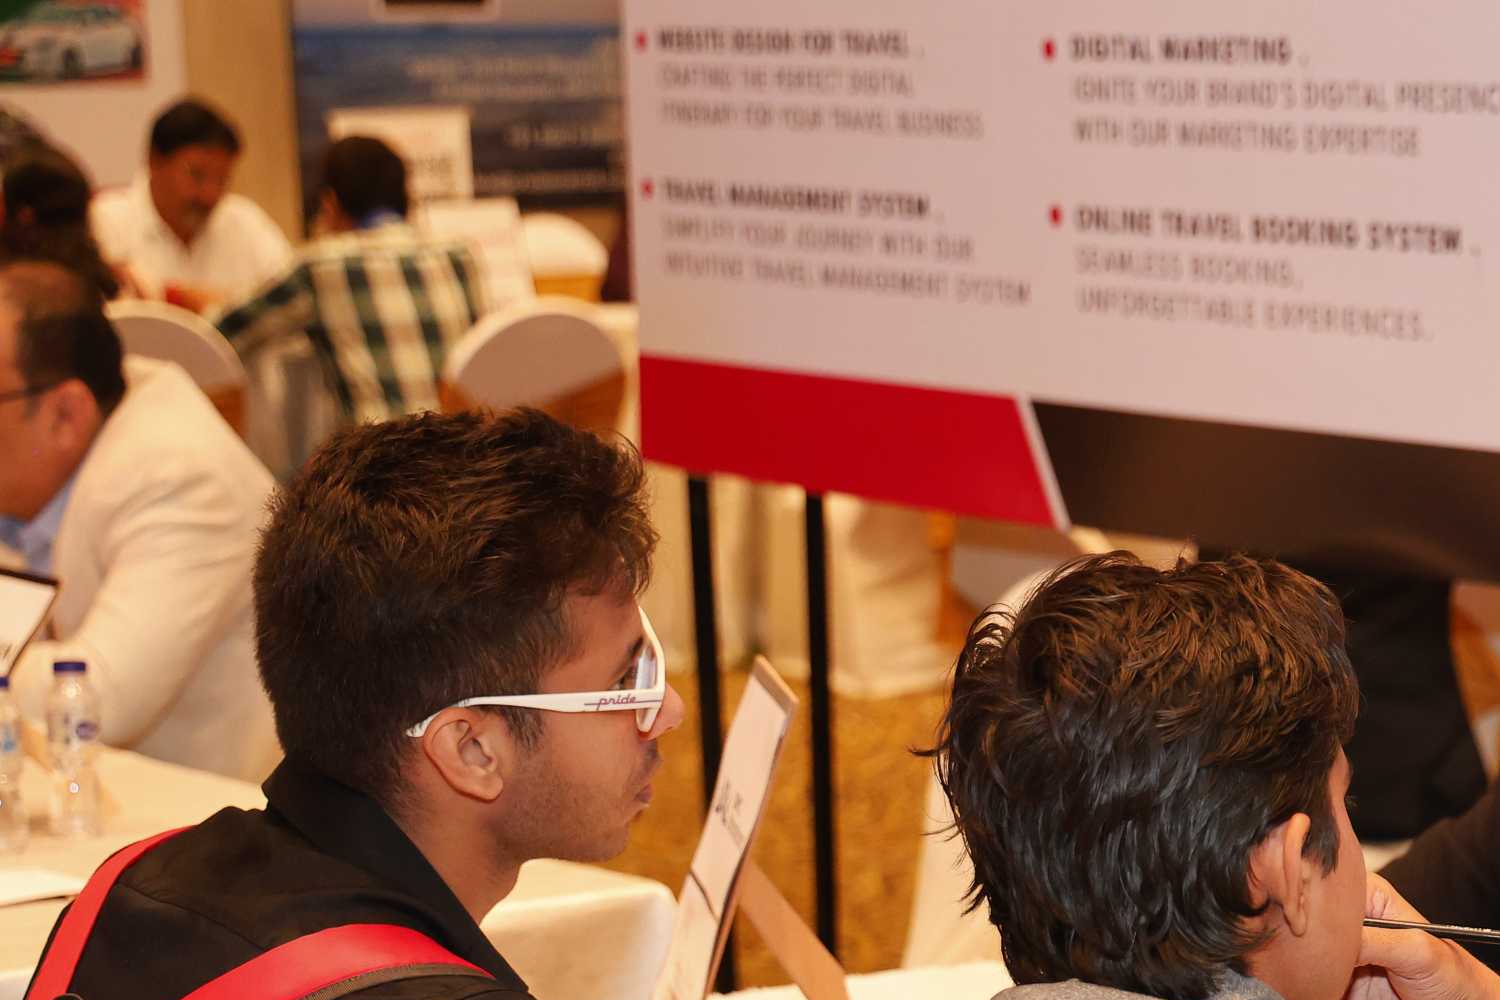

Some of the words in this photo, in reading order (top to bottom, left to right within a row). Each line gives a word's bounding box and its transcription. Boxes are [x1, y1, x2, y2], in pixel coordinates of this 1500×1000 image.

[1071, 36, 1152, 63] DIGITAL
[1160, 37, 1293, 65] MARKETING
[1303, 82, 1388, 112] DIGITAL
[1177, 122, 1296, 151] MARKETING
[1304, 126, 1421, 157] EXPERTISE
[1077, 205, 1152, 236] ONLINE
[1160, 210, 1242, 241] TRAVEL
[1251, 215, 1359, 247] BOOKING
[1367, 221, 1463, 254] SYSTEM
[597, 693, 636, 710] pride
